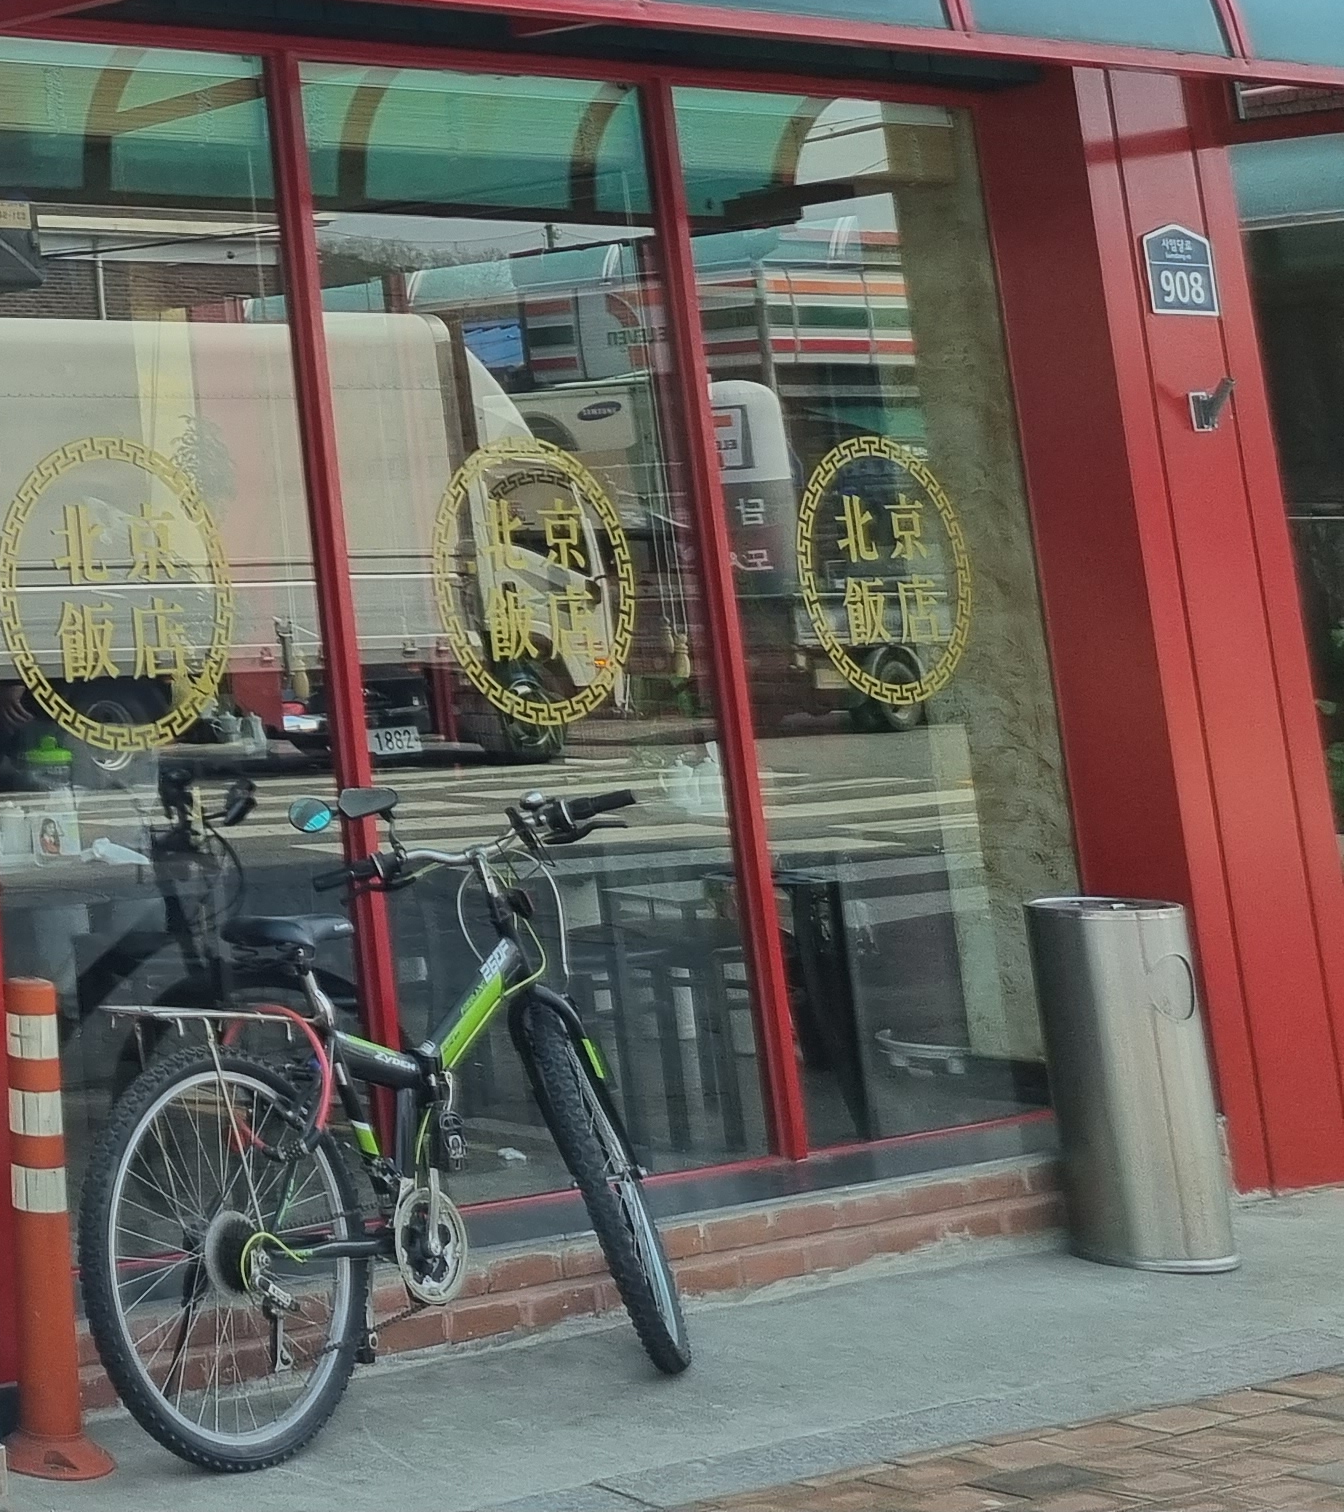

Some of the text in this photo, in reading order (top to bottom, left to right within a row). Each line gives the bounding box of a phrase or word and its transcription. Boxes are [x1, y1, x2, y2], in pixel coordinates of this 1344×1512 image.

[1161, 238, 1193, 253] 사임당로
[1160, 270, 1205, 304] 908
[50, 503, 179, 585] 北京
[484, 498, 586, 571] 北京
[834, 493, 929, 563] 北京
[55, 596, 187, 683] 飯店
[842, 575, 940, 646] 飯店
[374, 729, 415, 751] 1882
